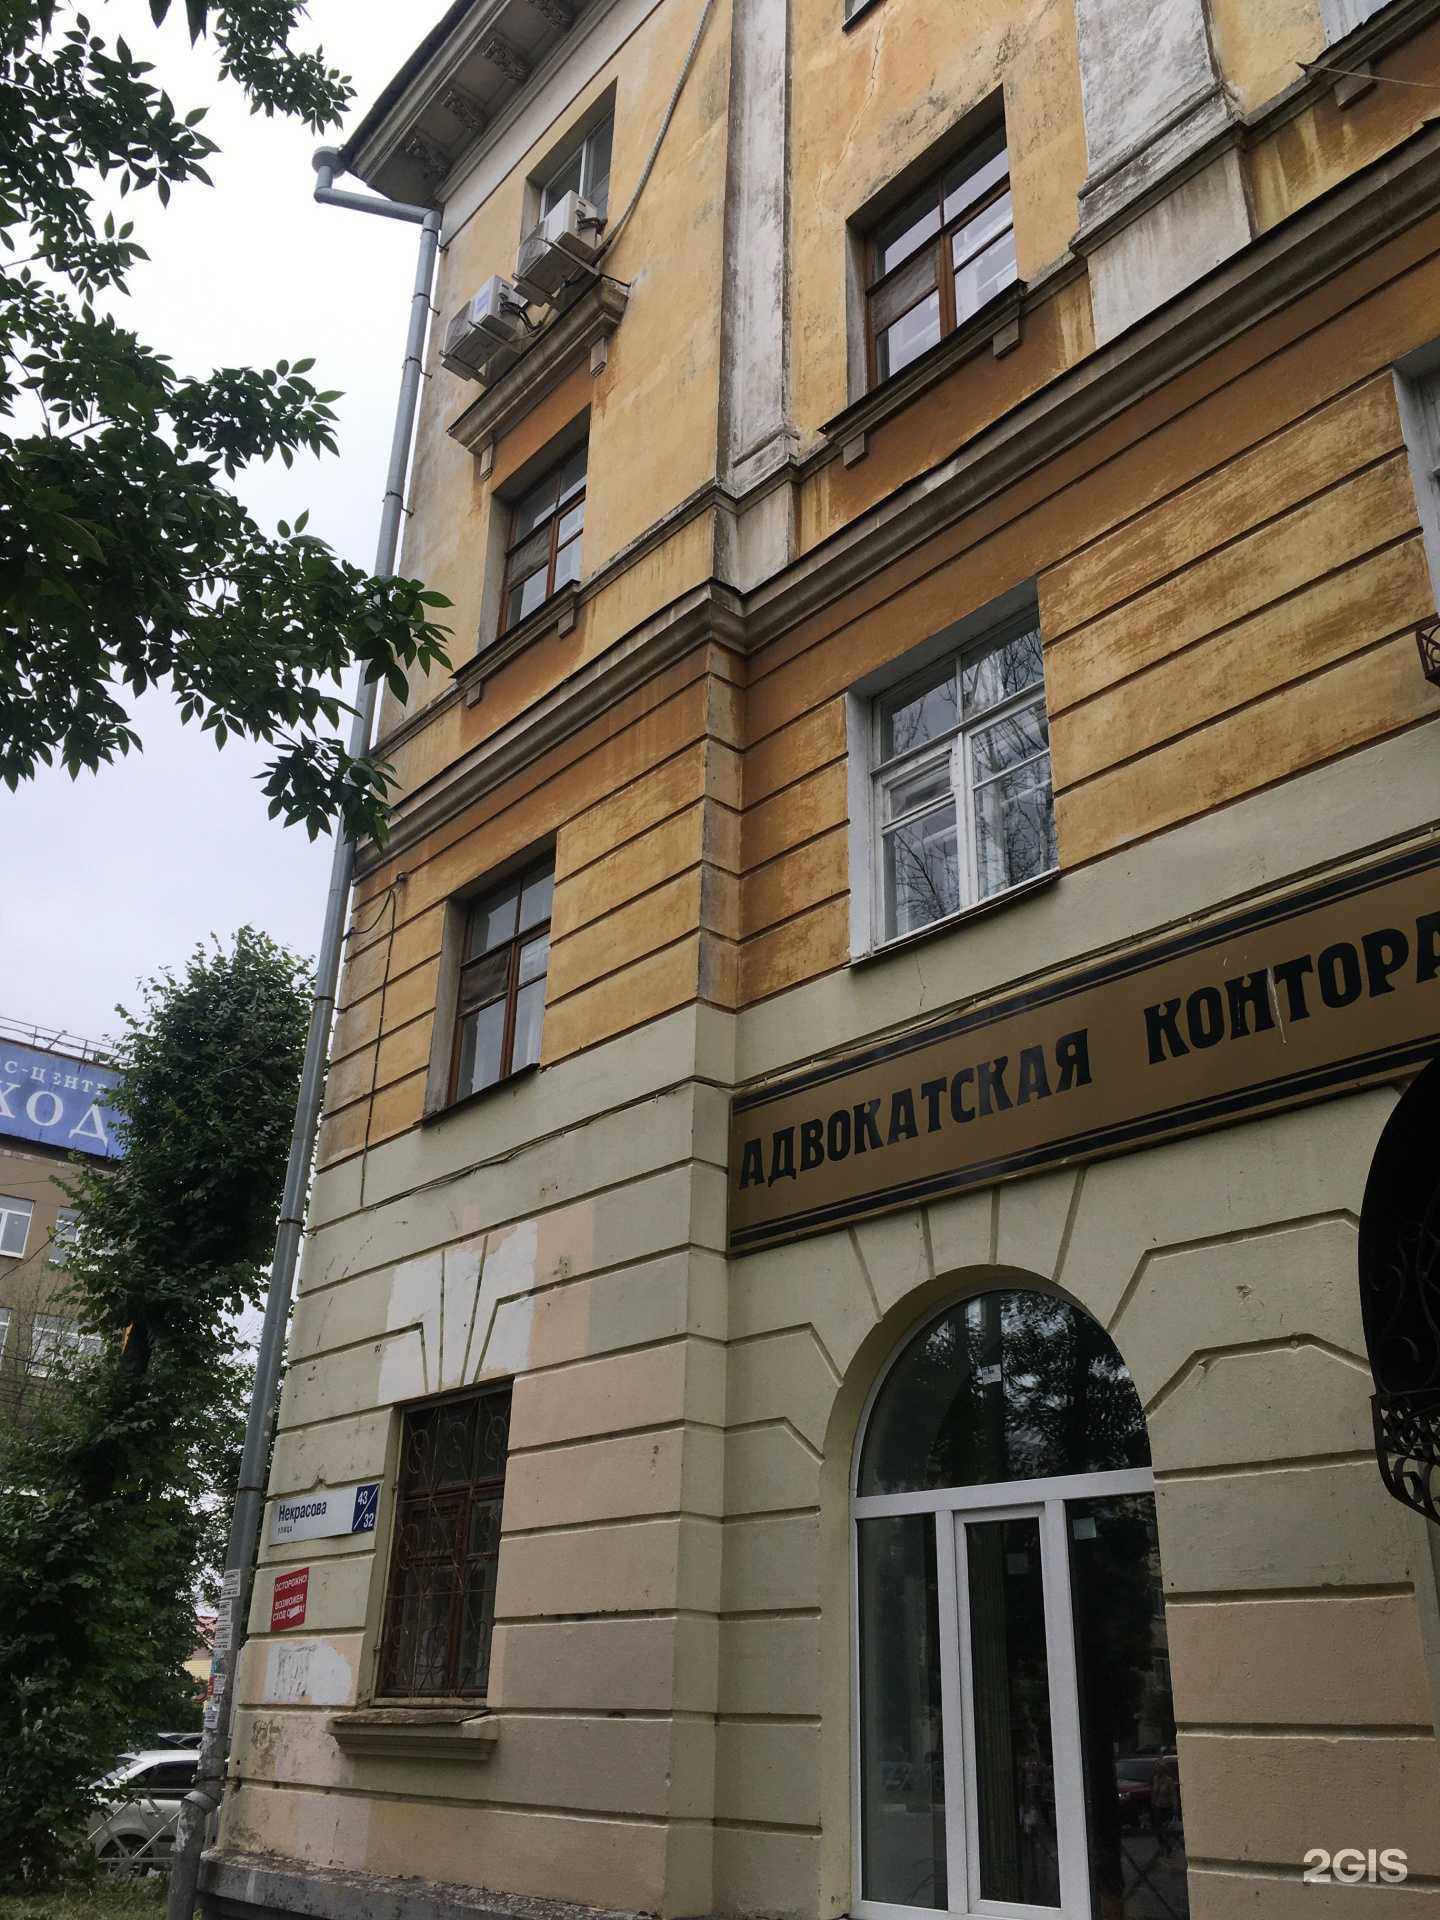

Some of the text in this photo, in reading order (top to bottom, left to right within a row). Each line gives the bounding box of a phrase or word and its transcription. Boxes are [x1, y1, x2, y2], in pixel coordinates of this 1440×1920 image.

[737, 910, 1440, 1192] АДВОКАТСКАЯ КОНТОРА
[278, 1501, 327, 1523] Некрасова
